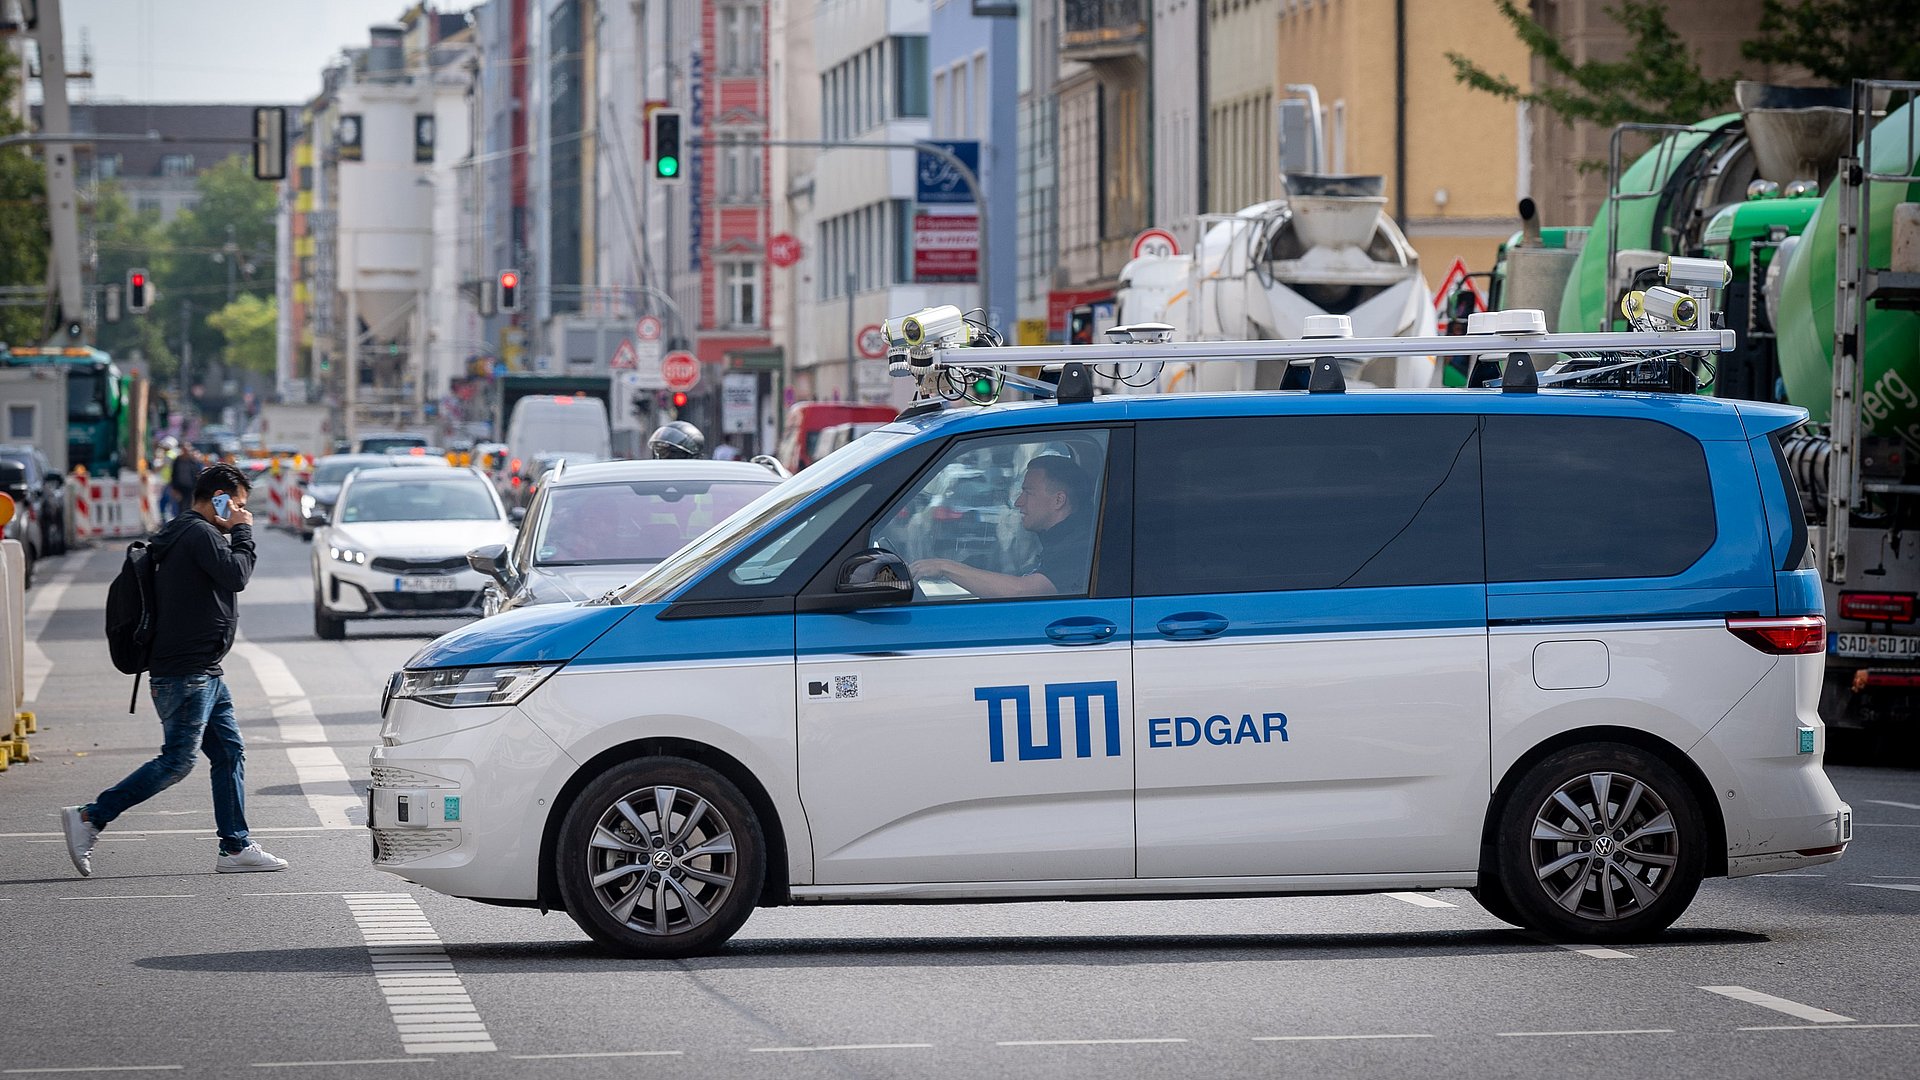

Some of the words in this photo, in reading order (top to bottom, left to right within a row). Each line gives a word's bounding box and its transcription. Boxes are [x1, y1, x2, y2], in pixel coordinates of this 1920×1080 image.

[1838, 635, 1867, 653] SAD
[1878, 638, 1897, 654] GD
[1900, 638, 1920, 656] 10
[974, 681, 1121, 762] TUM
[1149, 712, 1289, 748] EDGAR
